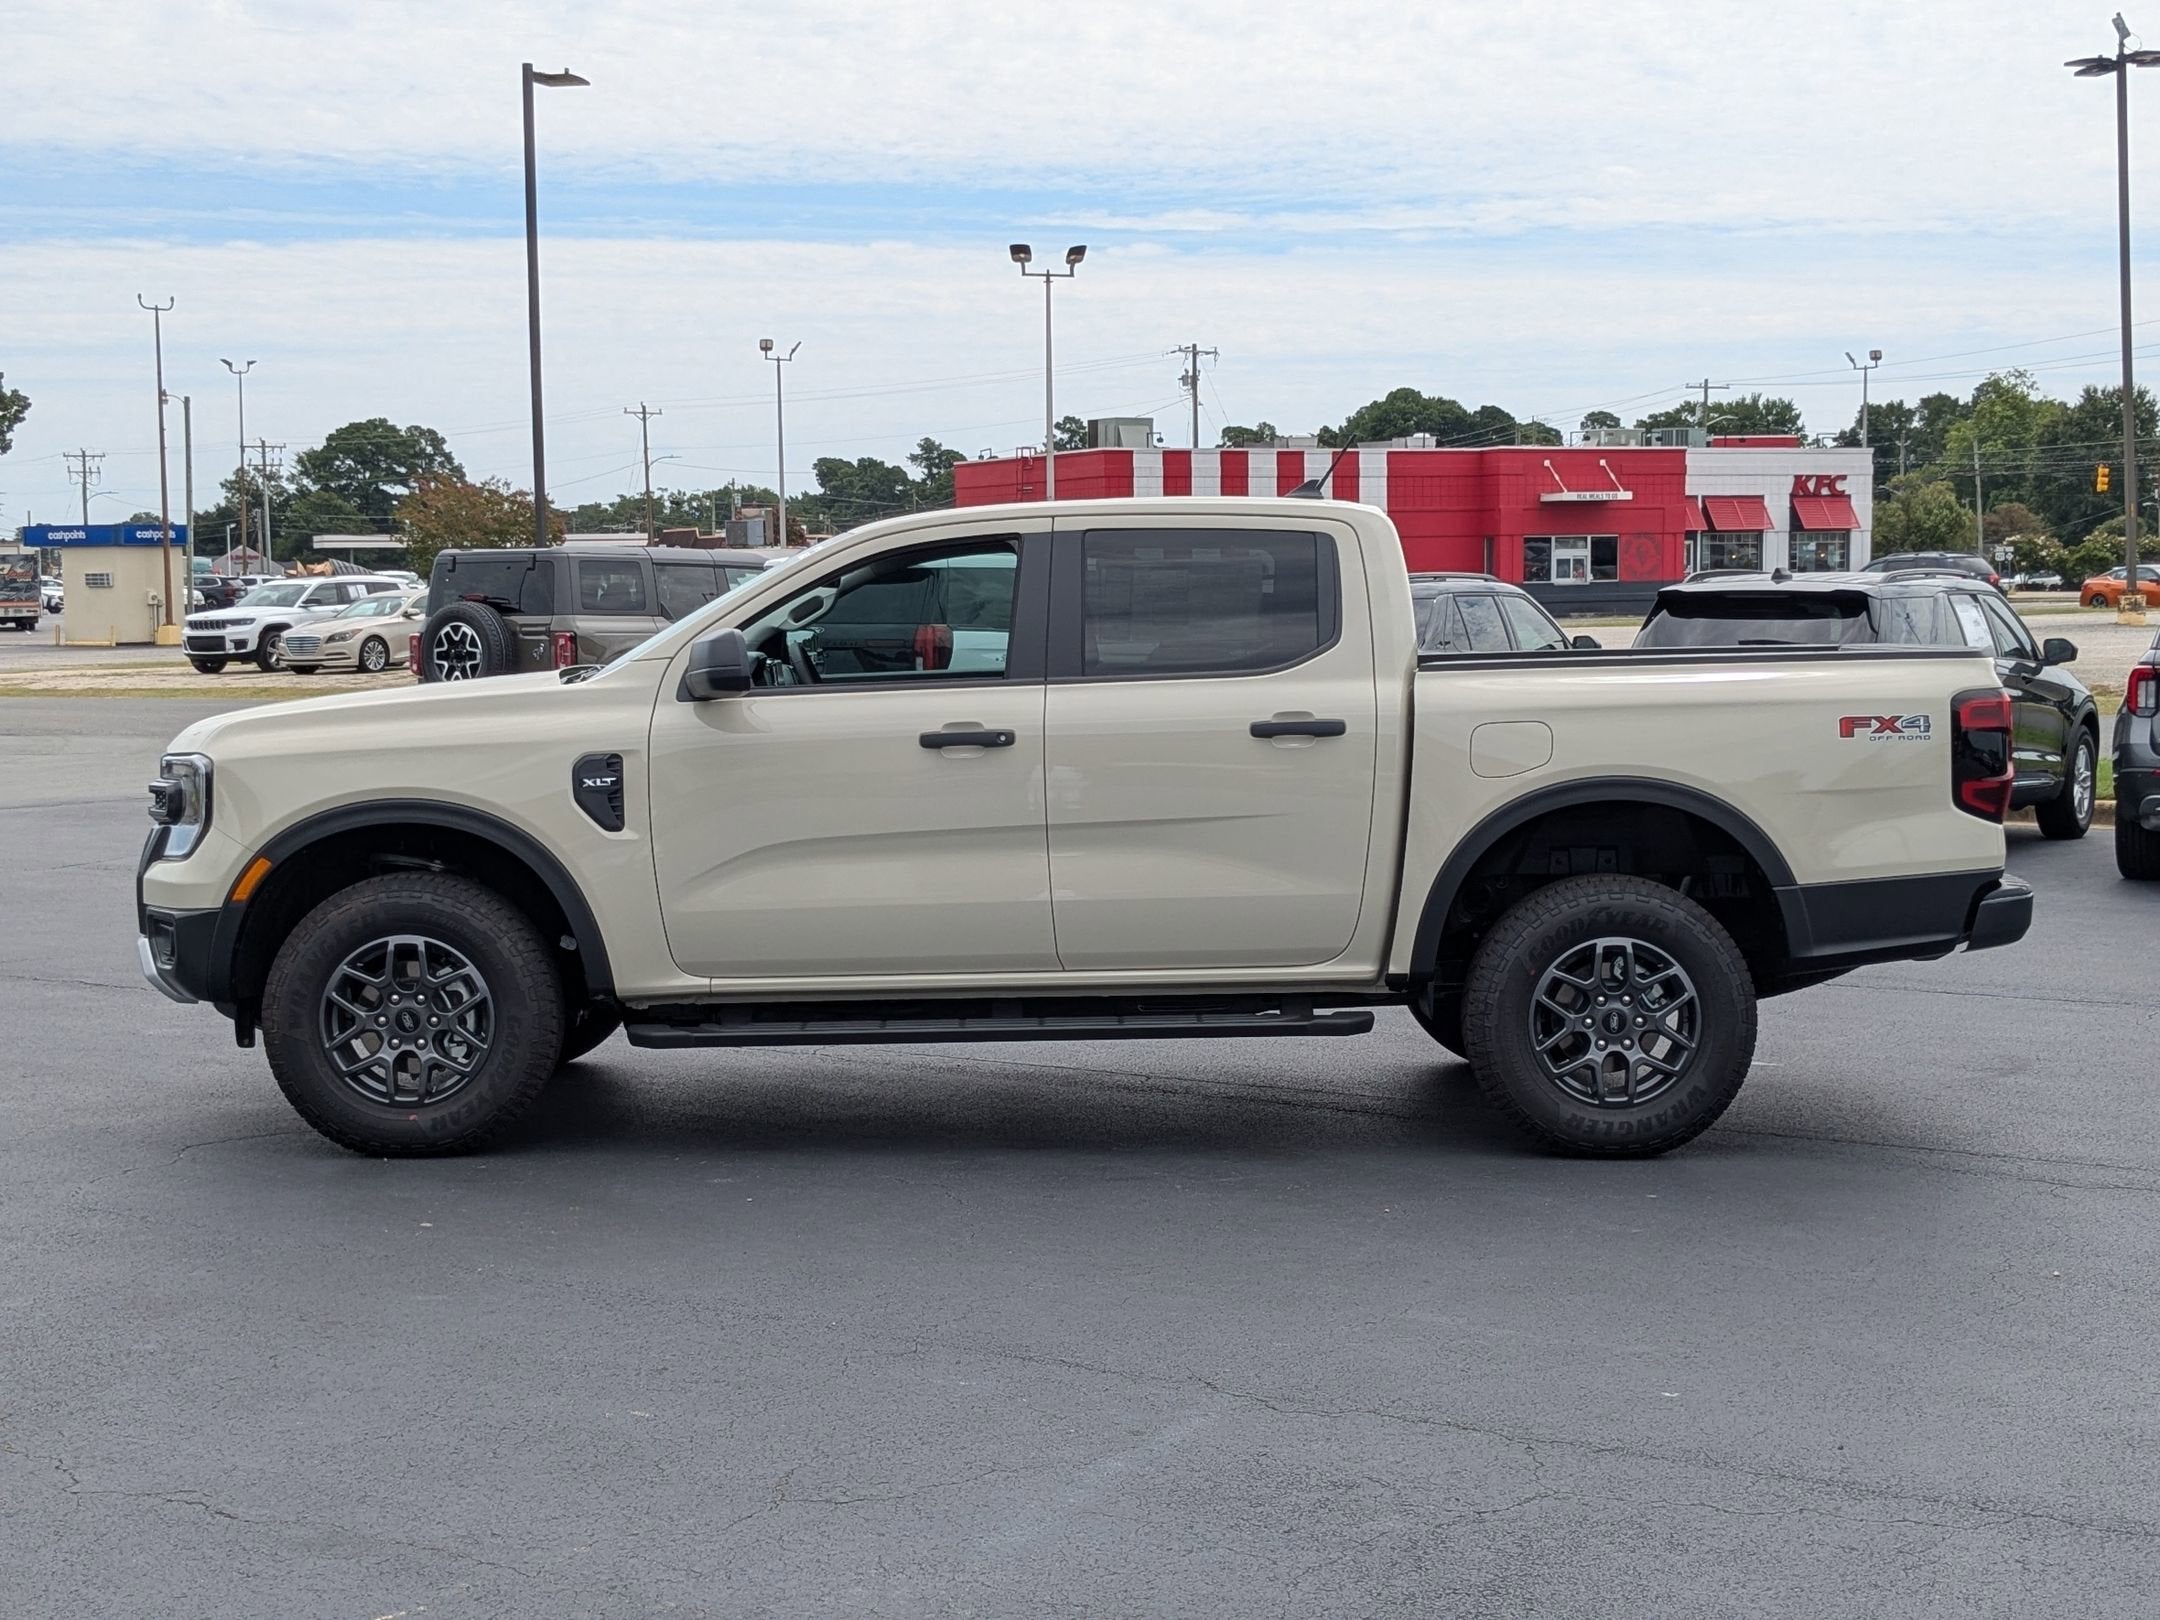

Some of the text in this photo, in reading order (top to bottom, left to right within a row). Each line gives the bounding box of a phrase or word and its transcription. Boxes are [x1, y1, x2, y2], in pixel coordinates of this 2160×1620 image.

[1792, 474, 1848, 496] KFC
[47, 529, 86, 542] cashpoints
[1838, 714, 1931, 739] FX4
[582, 777, 617, 788] XLT
[1528, 905, 1671, 963] GOODYEAR
[1565, 1082, 1708, 1137] WRANGLER
